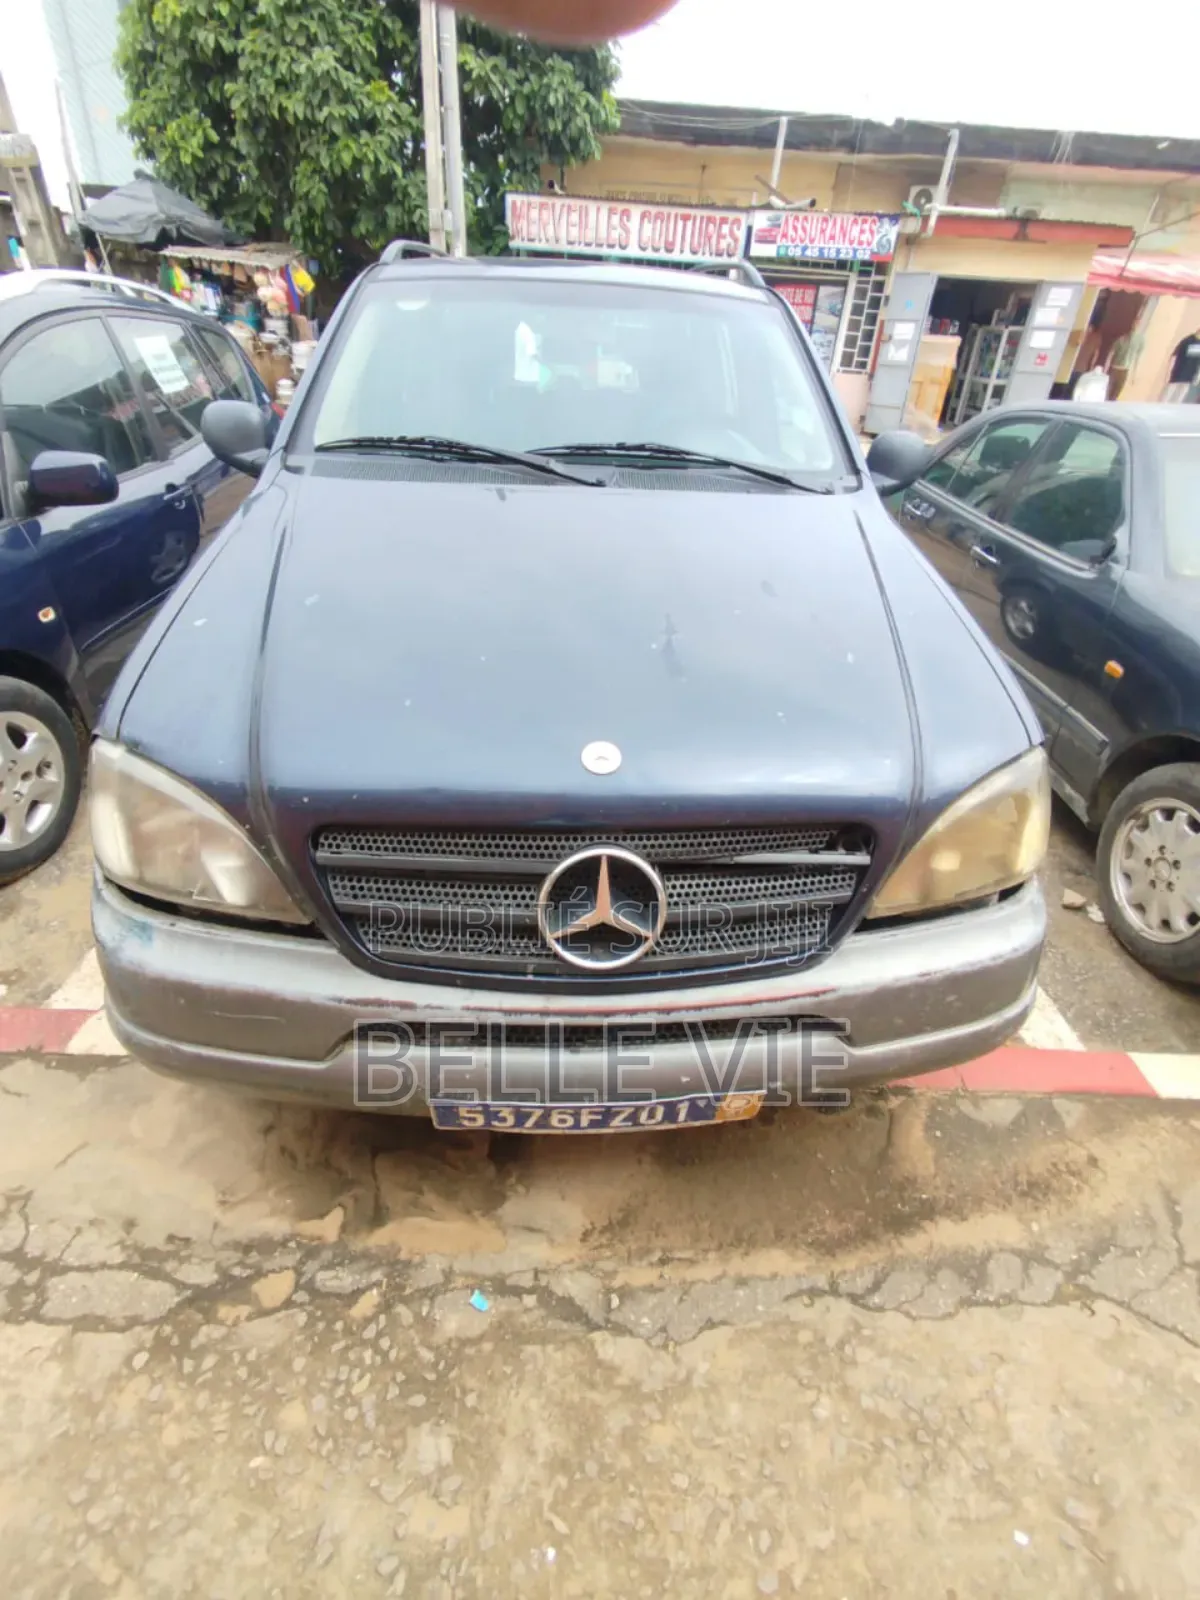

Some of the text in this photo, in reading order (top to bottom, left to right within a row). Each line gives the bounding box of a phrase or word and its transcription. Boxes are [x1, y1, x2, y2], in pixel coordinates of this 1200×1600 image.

[511, 199, 742, 258] MERVEILLES COUTURES
[779, 212, 878, 247] ASSURANCES
